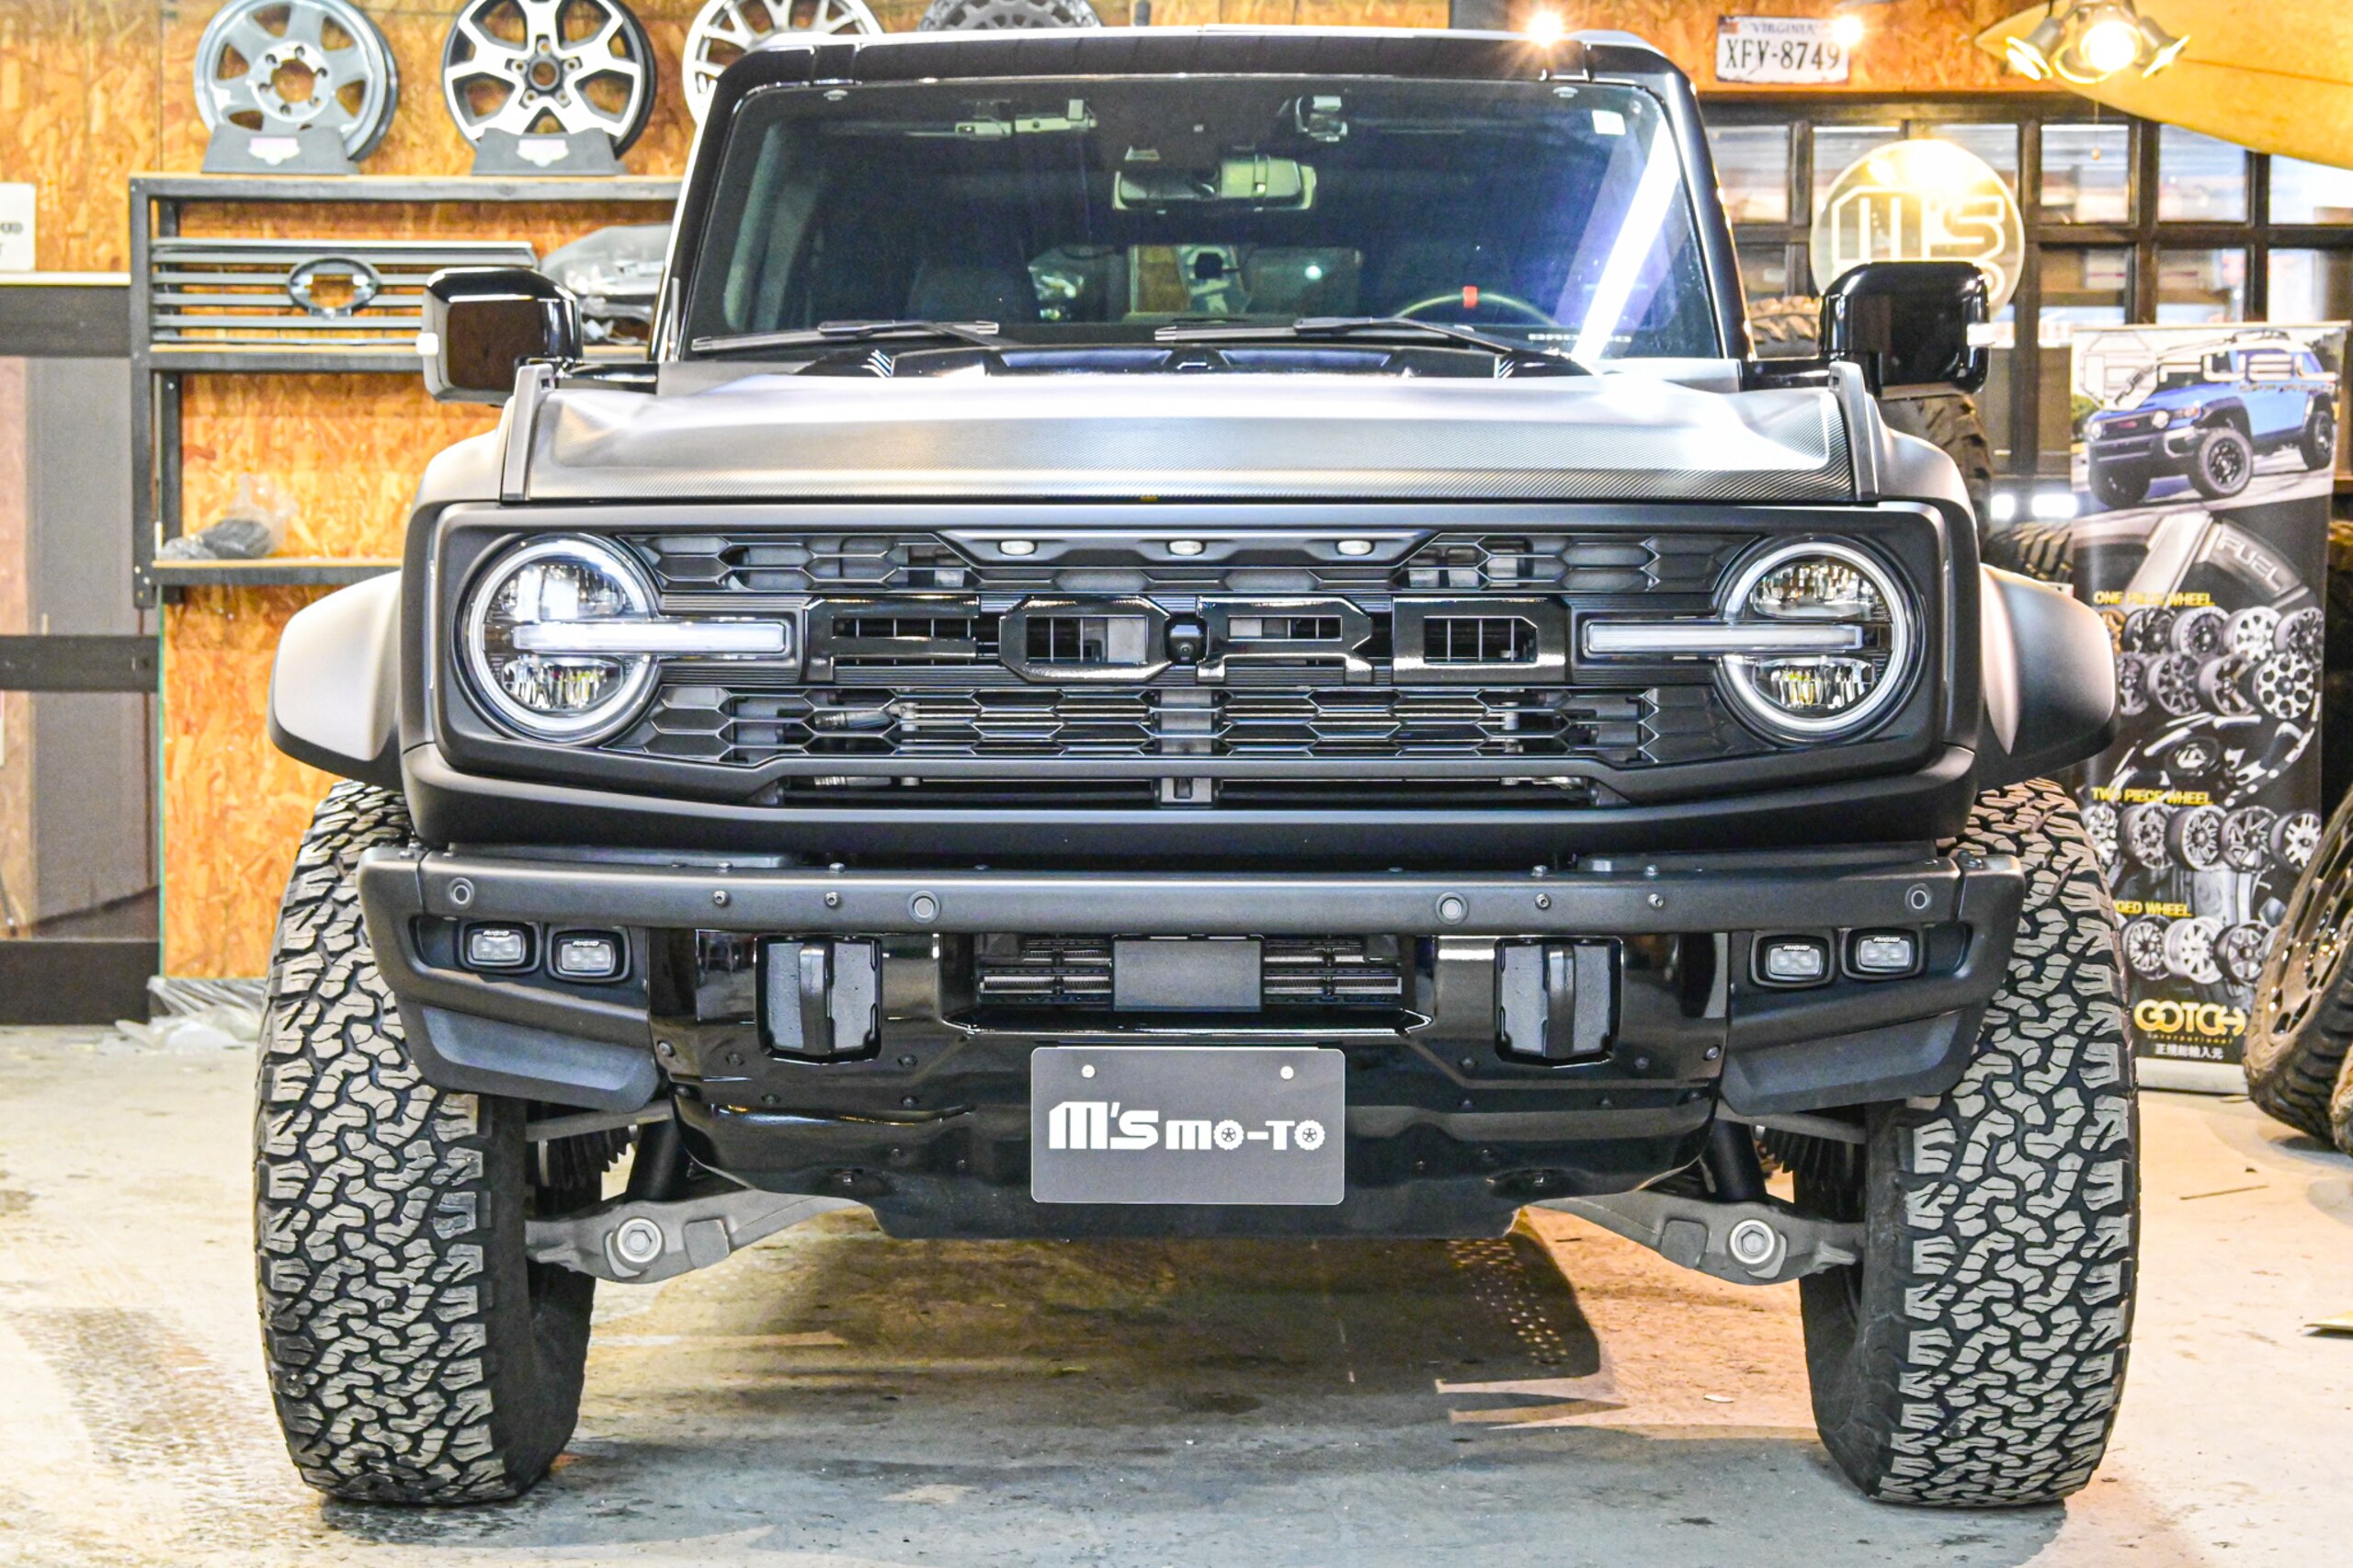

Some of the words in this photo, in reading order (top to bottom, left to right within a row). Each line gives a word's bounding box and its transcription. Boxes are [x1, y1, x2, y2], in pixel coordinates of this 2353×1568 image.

[1750, 21, 1816, 33] VIRGINIA
[1726, 40, 1840, 70] XFV-8749
[2158, 353, 2337, 382] FUEL
[2216, 535, 2282, 591] FUEL
[2093, 590, 2123, 605] ONE
[2168, 592, 2215, 607] WHEEL
[803, 594, 1566, 684] FORD
[2090, 787, 2122, 801] TWO
[2124, 789, 2163, 803] PIECE
[2166, 790, 2213, 806] WHEEL
[2113, 900, 2143, 915] GED
[2144, 902, 2192, 917] WHEEL
[2134, 999, 2246, 1037] GOTCH
